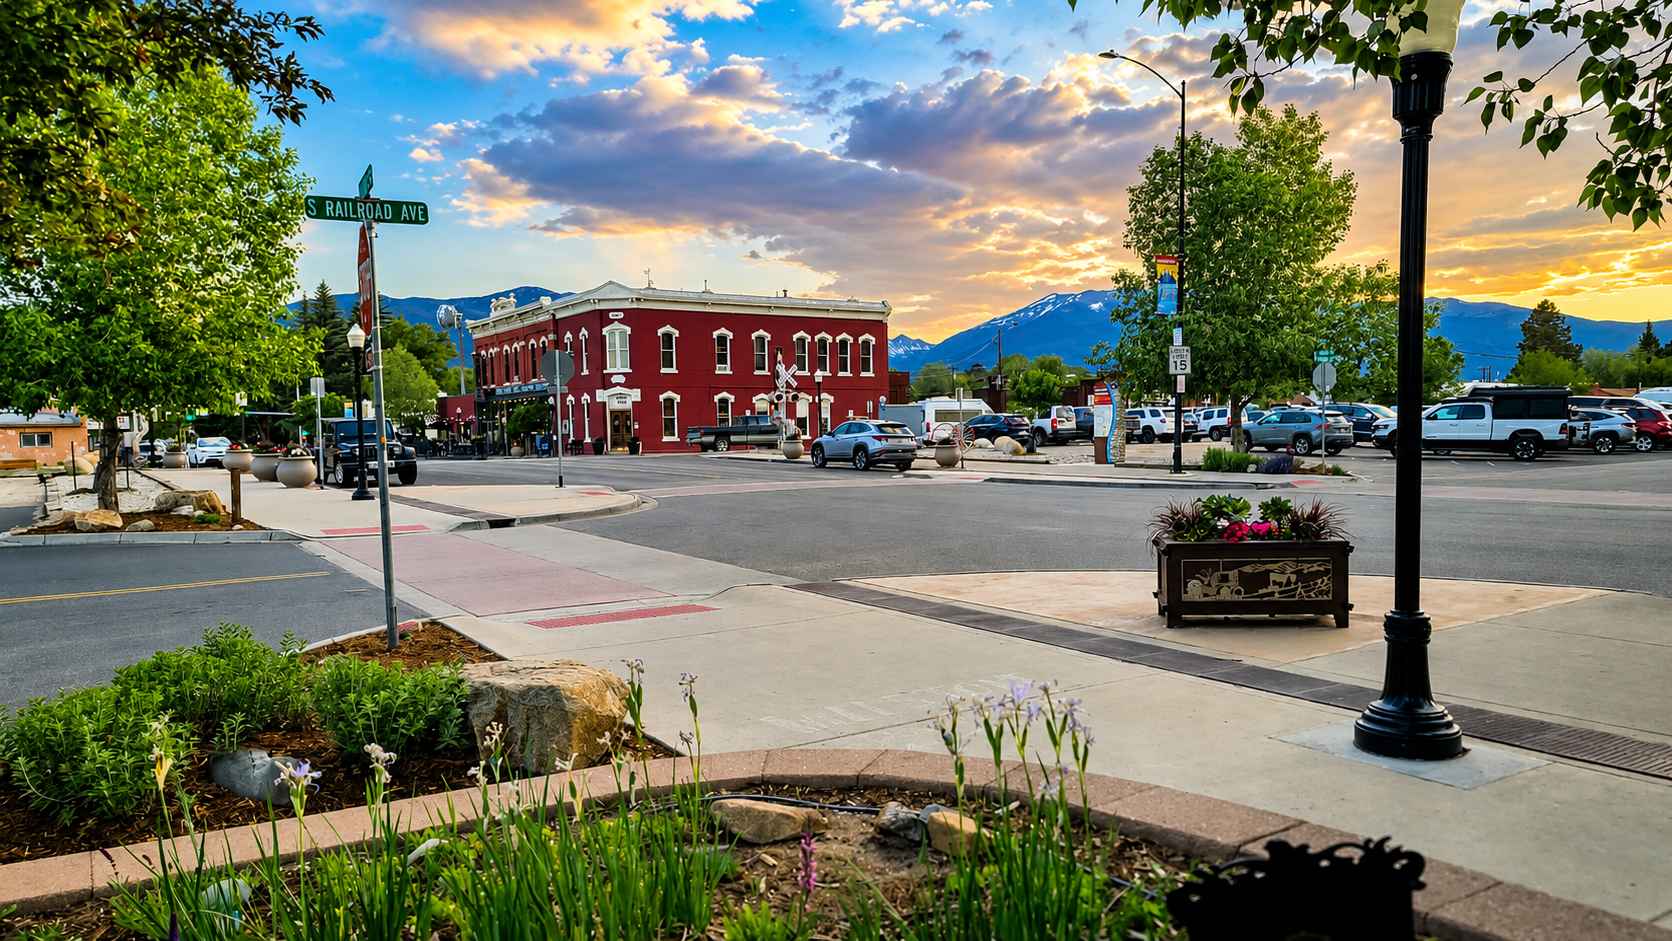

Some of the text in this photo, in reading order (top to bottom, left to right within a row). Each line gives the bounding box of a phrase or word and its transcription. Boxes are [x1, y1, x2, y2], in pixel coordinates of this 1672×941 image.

[307, 198, 425, 221] S RAILROAD AVE
[1172, 360, 1188, 371] 15
